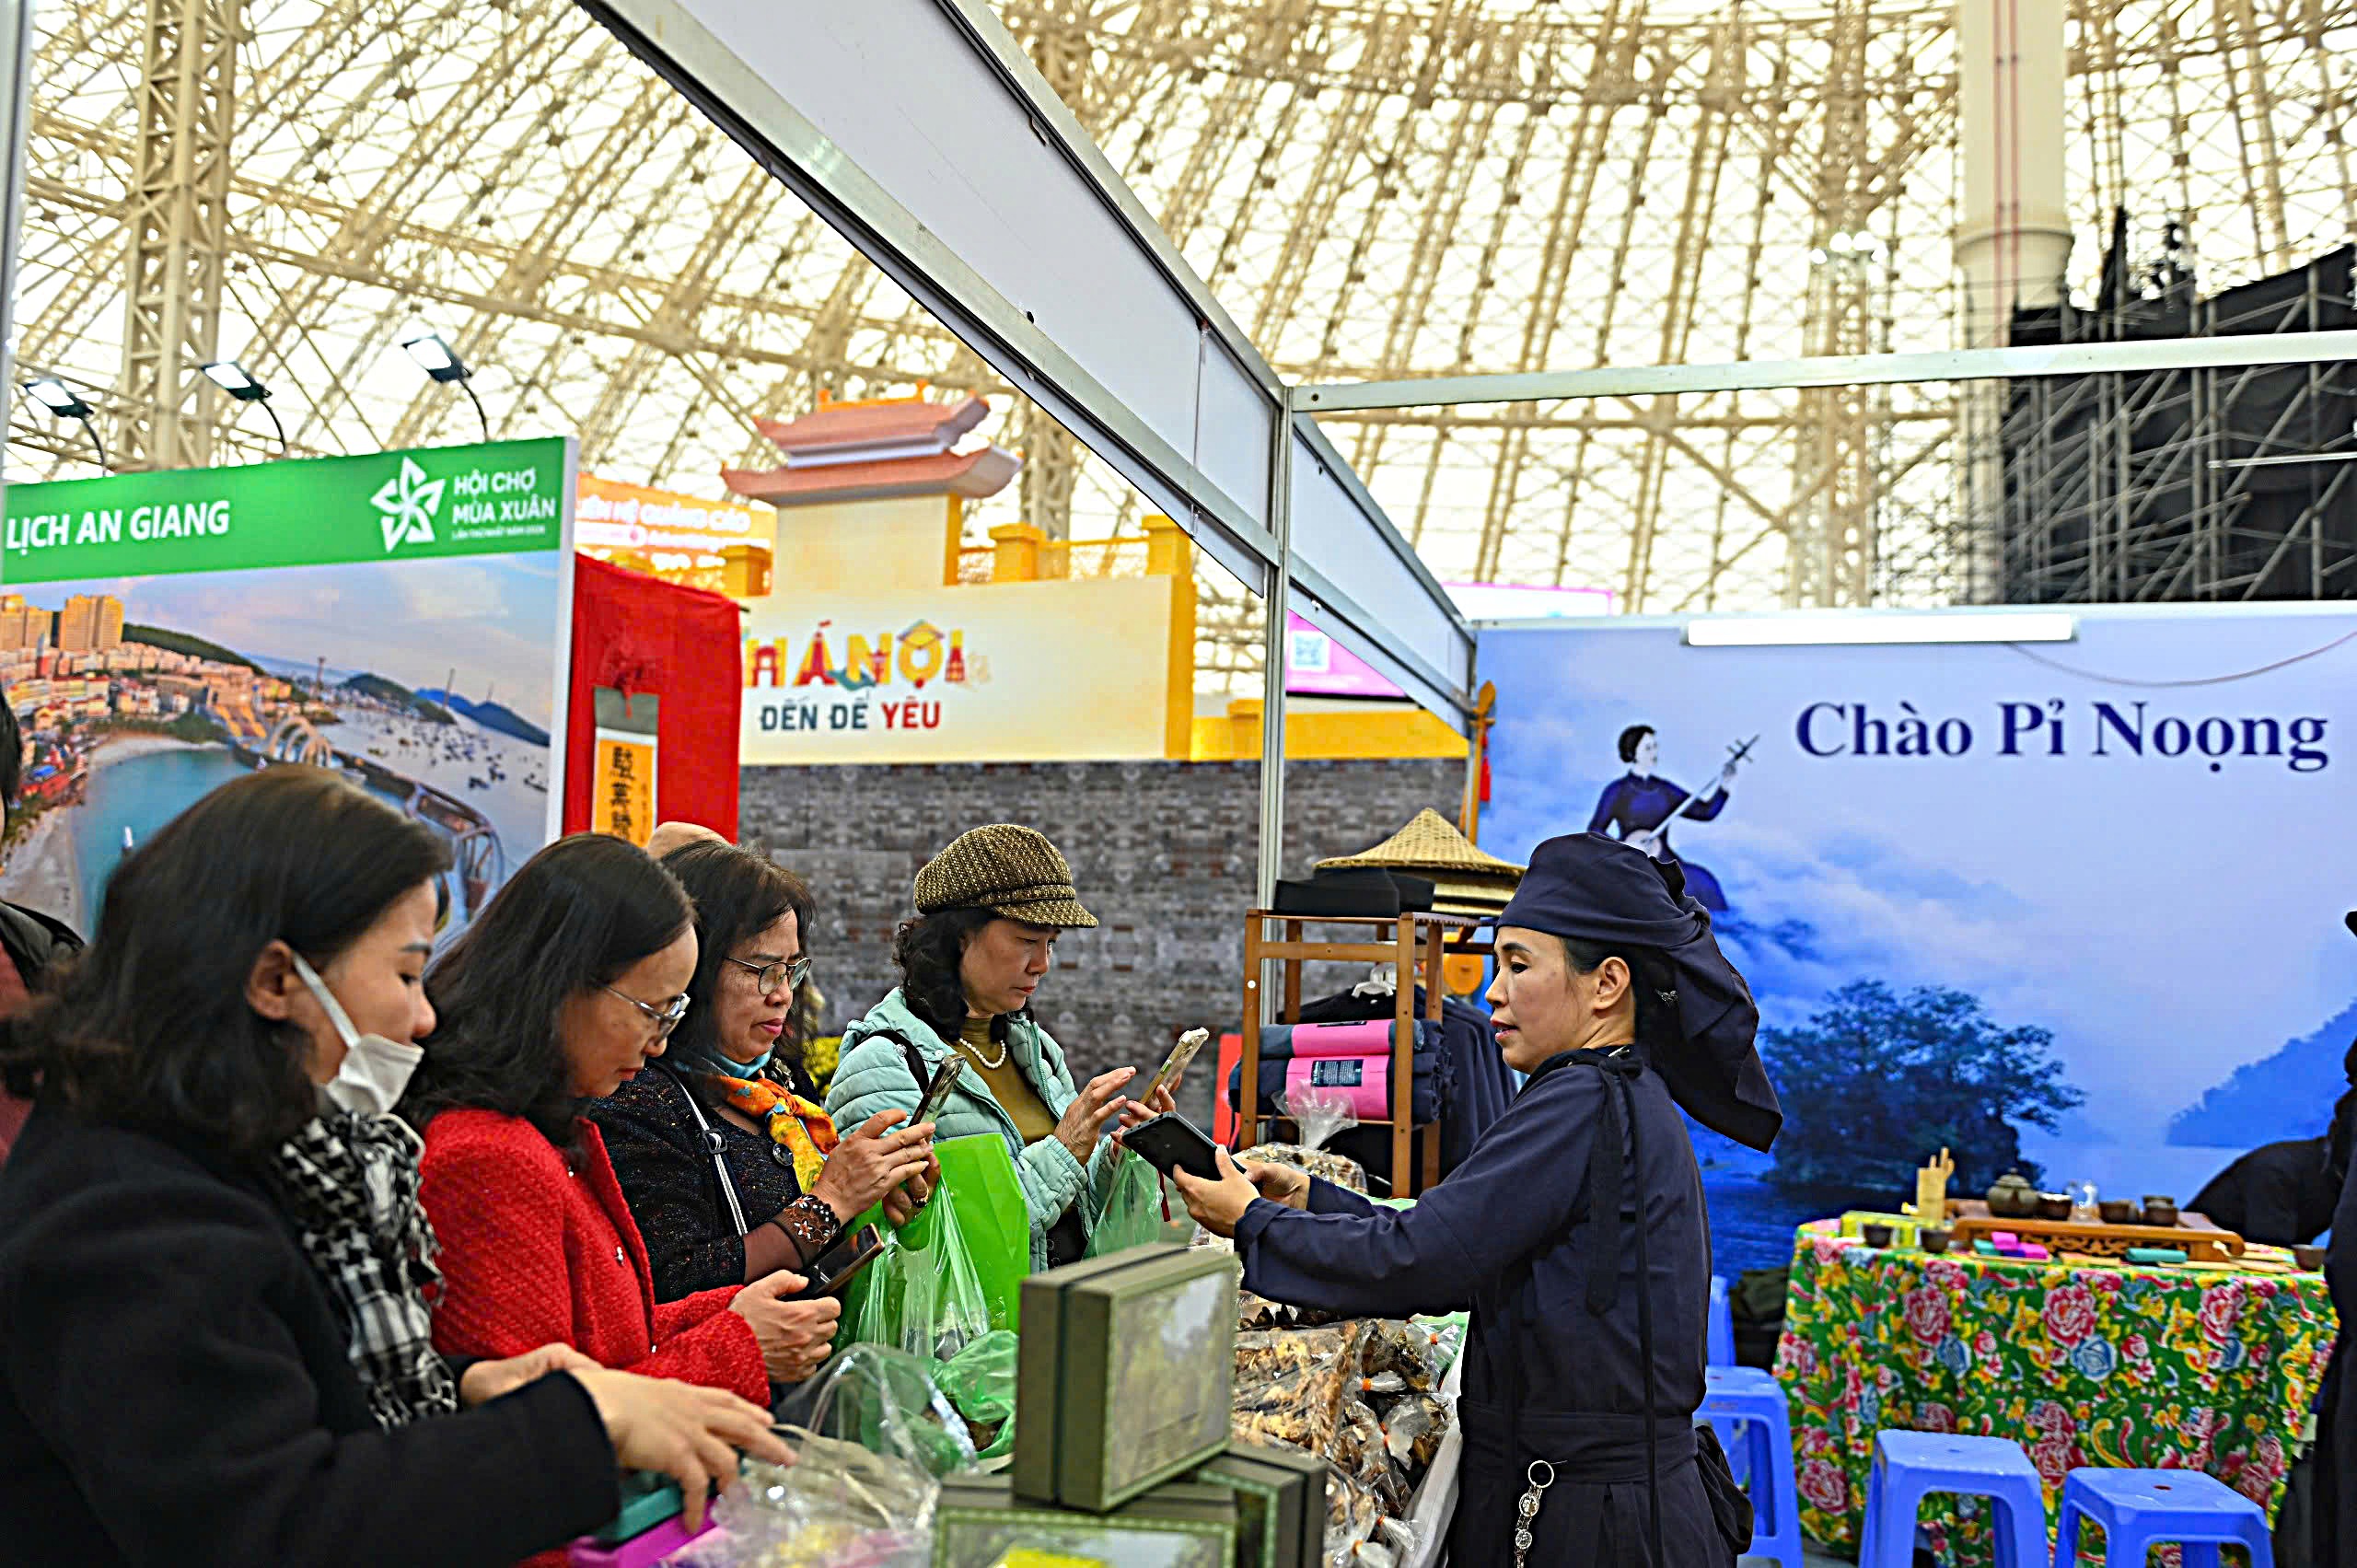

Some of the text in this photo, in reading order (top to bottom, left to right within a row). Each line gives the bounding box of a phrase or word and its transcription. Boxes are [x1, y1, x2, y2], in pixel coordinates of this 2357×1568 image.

[454, 466, 536, 498] HỘI CHỢ
[6, 499, 230, 556] LỊCH AN GIANG
[452, 493, 556, 526] MÙA XUÂN
[759, 694, 819, 731] ĐẾN
[881, 694, 941, 729] YÊU
[1795, 698, 2329, 772] Chào Pỉ Noọng
